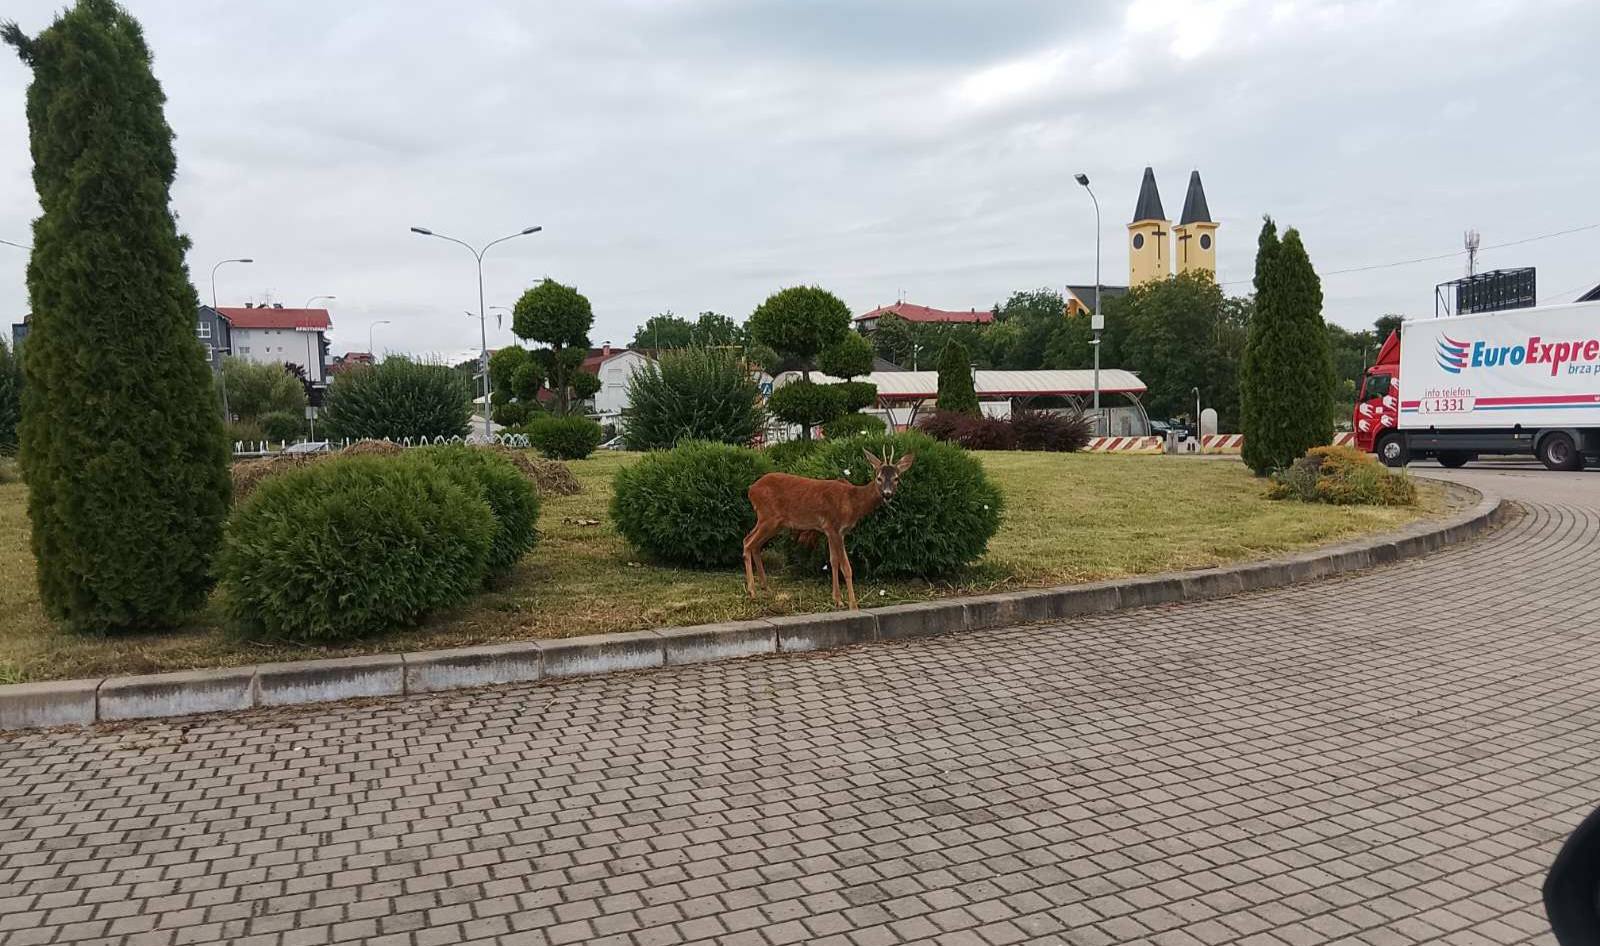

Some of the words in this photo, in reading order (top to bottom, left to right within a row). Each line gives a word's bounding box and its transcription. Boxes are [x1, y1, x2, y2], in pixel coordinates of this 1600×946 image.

[1471, 337, 1600, 376] EuroExpre
[1568, 363, 1591, 375] brza
[1425, 388, 1440, 397] info
[1442, 386, 1471, 397] telefon
[1434, 399, 1464, 411] 1331
